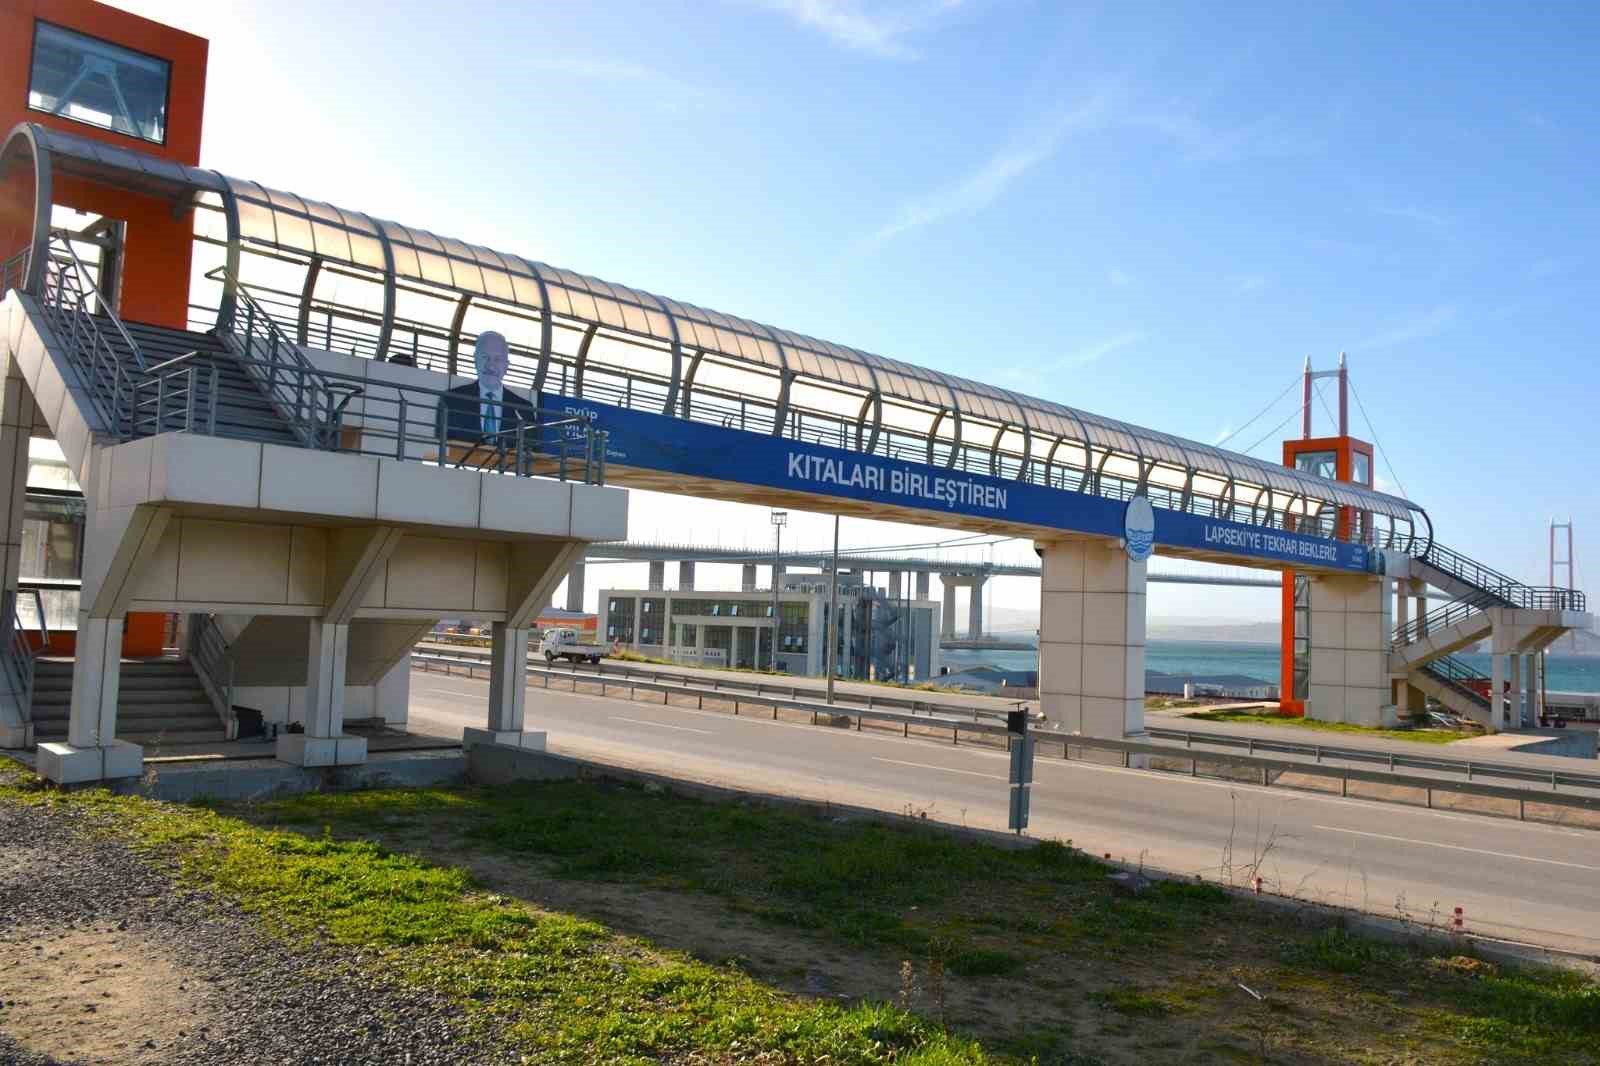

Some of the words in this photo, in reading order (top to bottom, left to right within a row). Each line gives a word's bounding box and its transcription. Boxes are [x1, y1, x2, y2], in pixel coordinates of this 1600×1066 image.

[788, 452, 884, 491] KITALARI
[890, 466, 1007, 510] BİRLEŞTİREN
[1261, 534, 1298, 555] TEKRAR
[1299, 540, 1337, 562] BEKLERİZ
